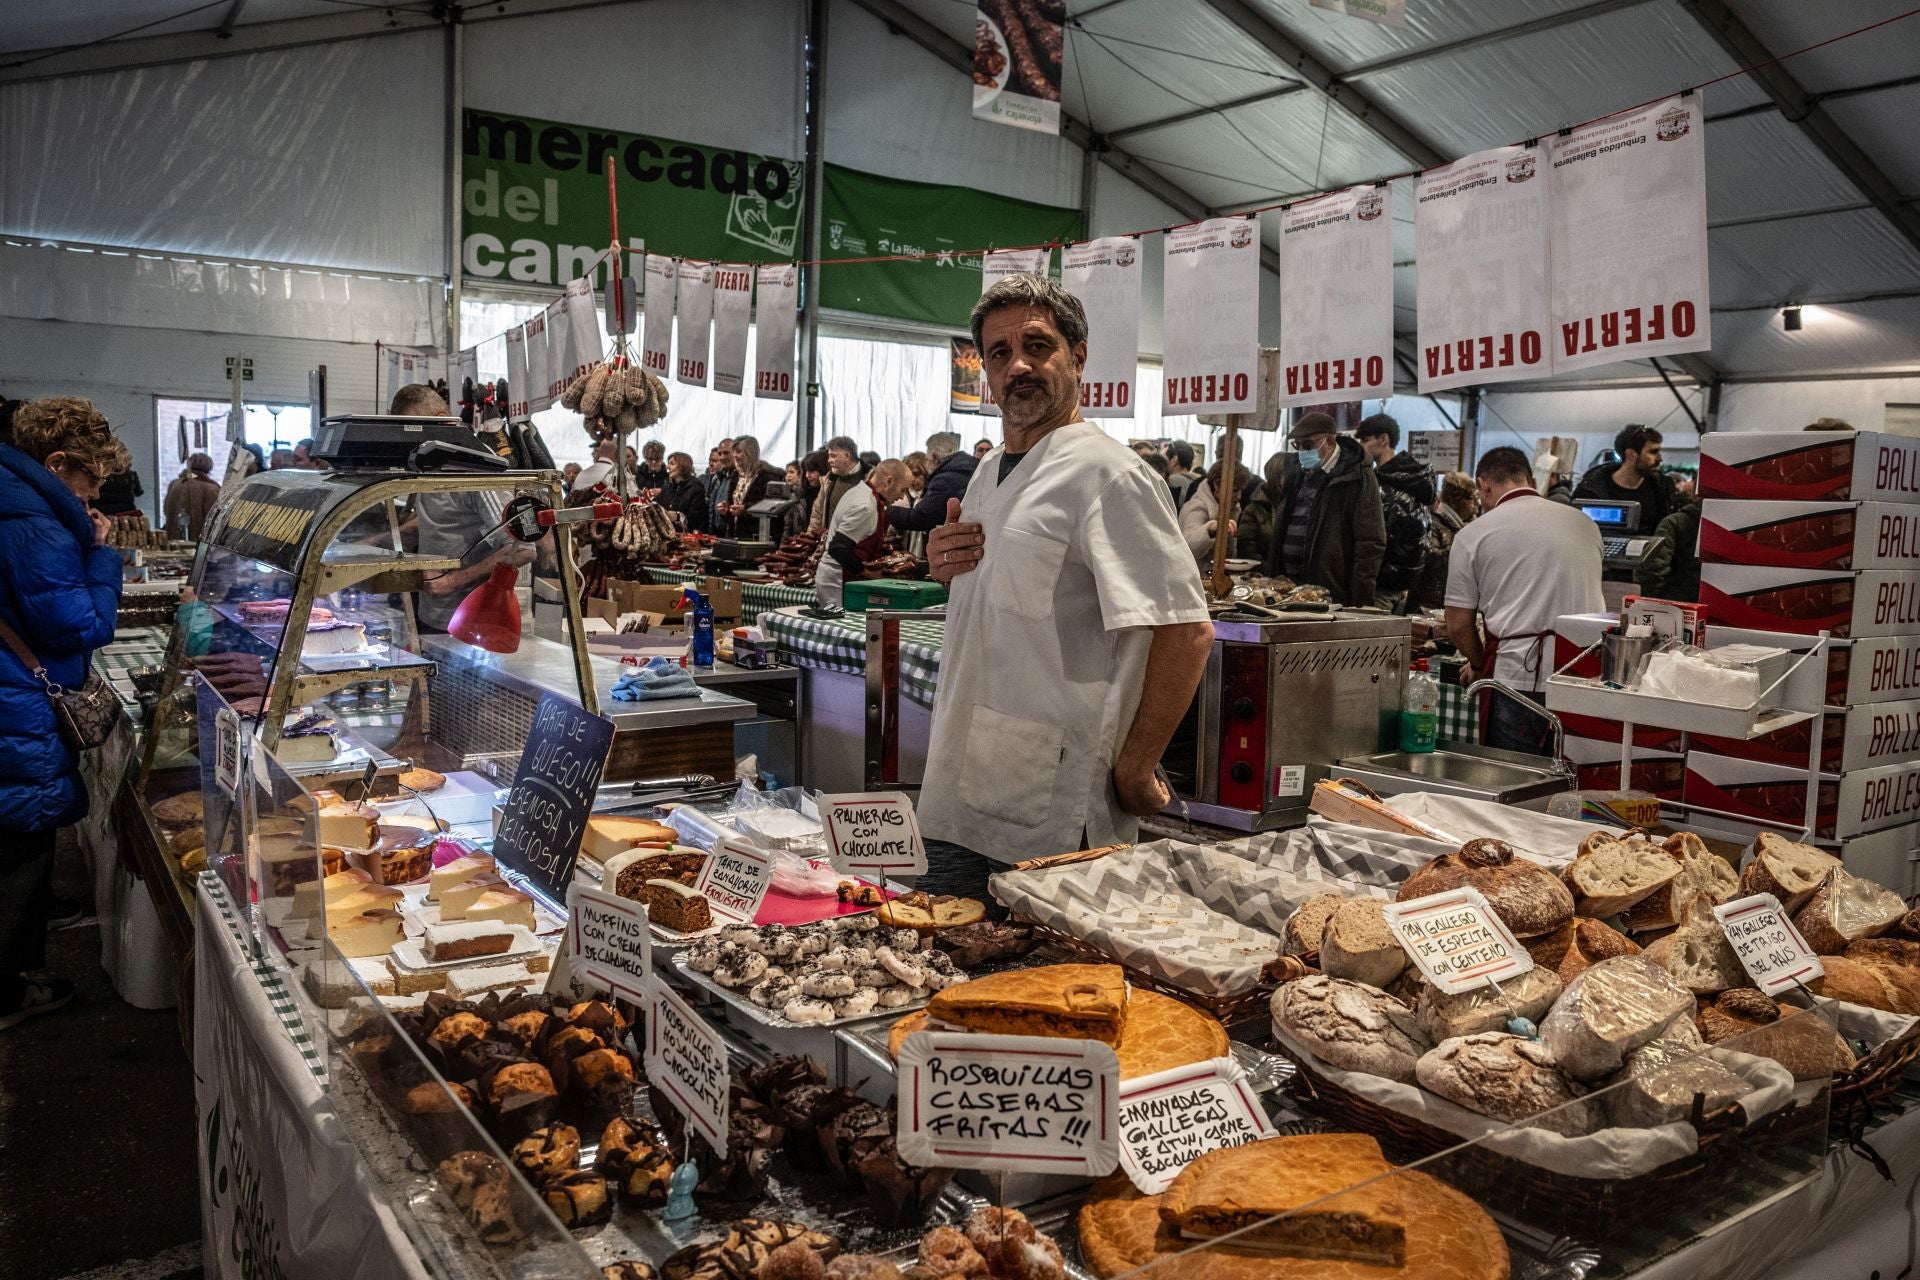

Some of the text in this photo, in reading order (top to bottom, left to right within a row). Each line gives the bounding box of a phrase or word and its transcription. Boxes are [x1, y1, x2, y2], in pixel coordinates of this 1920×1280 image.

[462, 114, 790, 200] mercado
[1599, 135, 1647, 154] Embutidos
[1553, 149, 1597, 169] Ballesteros
[463, 168, 559, 226] del
[1419, 189, 1456, 204] Ballesteros
[1458, 176, 1497, 192] Embutidos
[1284, 221, 1315, 235] Ballesteros
[1317, 213, 1349, 225] Embutidos
[891, 242, 925, 259] La Rioja
[714, 271, 749, 292] OFERTA
[1562, 300, 1696, 356] OFERTA
[1425, 330, 1541, 378] OFERTA
[1167, 372, 1248, 404] OFERTA
[1286, 355, 1383, 395] OFERTA
[1080, 381, 1129, 408] OFER
[535, 698, 588, 743] TARTA DE
[509, 786, 579, 848] CREMOSA Y
[833, 808, 904, 827] PALMERAS
[1637, 803, 1659, 823] 200
[852, 828, 878, 838] CON
[718, 854, 759, 877] TARTA DE
[583, 906, 640, 937] MUFFINS
[1402, 911, 1477, 939] PAN GALLEGO
[1726, 914, 1777, 941] PAN GALLEGO
[583, 924, 642, 960] CON CREMA
[585, 945, 598, 961] DE
[1417, 926, 1496, 957] DE ESPELTA
[1738, 942, 1754, 957] DE
[1433, 943, 1507, 976] CON CENTENO
[1750, 958, 1772, 975] DEL
[927, 1057, 1093, 1089] ROSQUILLAS
[930, 1091, 1084, 1113] CASERAS
[1120, 1088, 1215, 1129] EMPANADAS
[926, 1114, 1050, 1139] FRITAS
[1126, 1099, 1229, 1144] GALLEGAS
[1133, 1145, 1151, 1161] DE
[1204, 1117, 1251, 1141] CARNE
